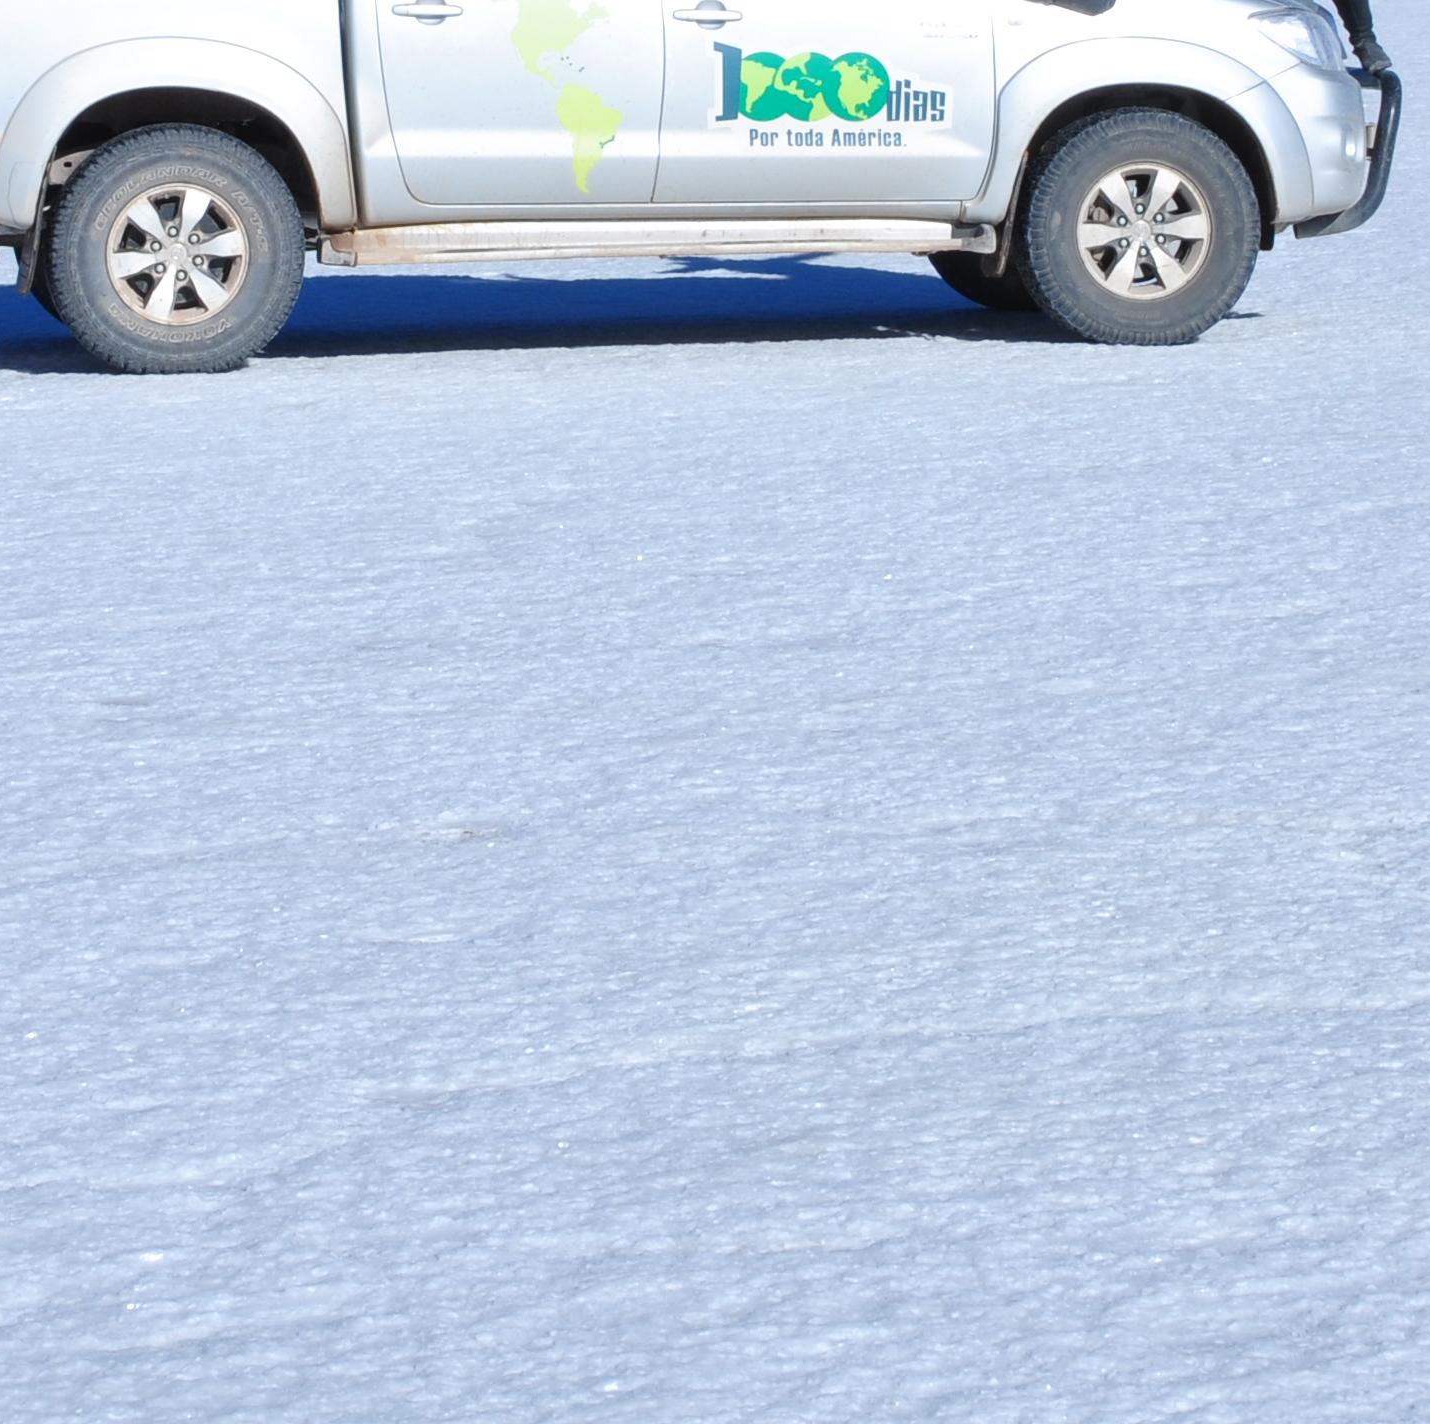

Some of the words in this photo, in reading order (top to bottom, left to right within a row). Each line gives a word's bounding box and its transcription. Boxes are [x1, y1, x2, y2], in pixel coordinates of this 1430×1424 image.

[749, 128, 778, 147] Por
[787, 128, 824, 147] toda
[831, 127, 907, 147] América.
[94, 165, 228, 231] GEOLANDAR
[107, 302, 232, 343] YOKOHAMA
